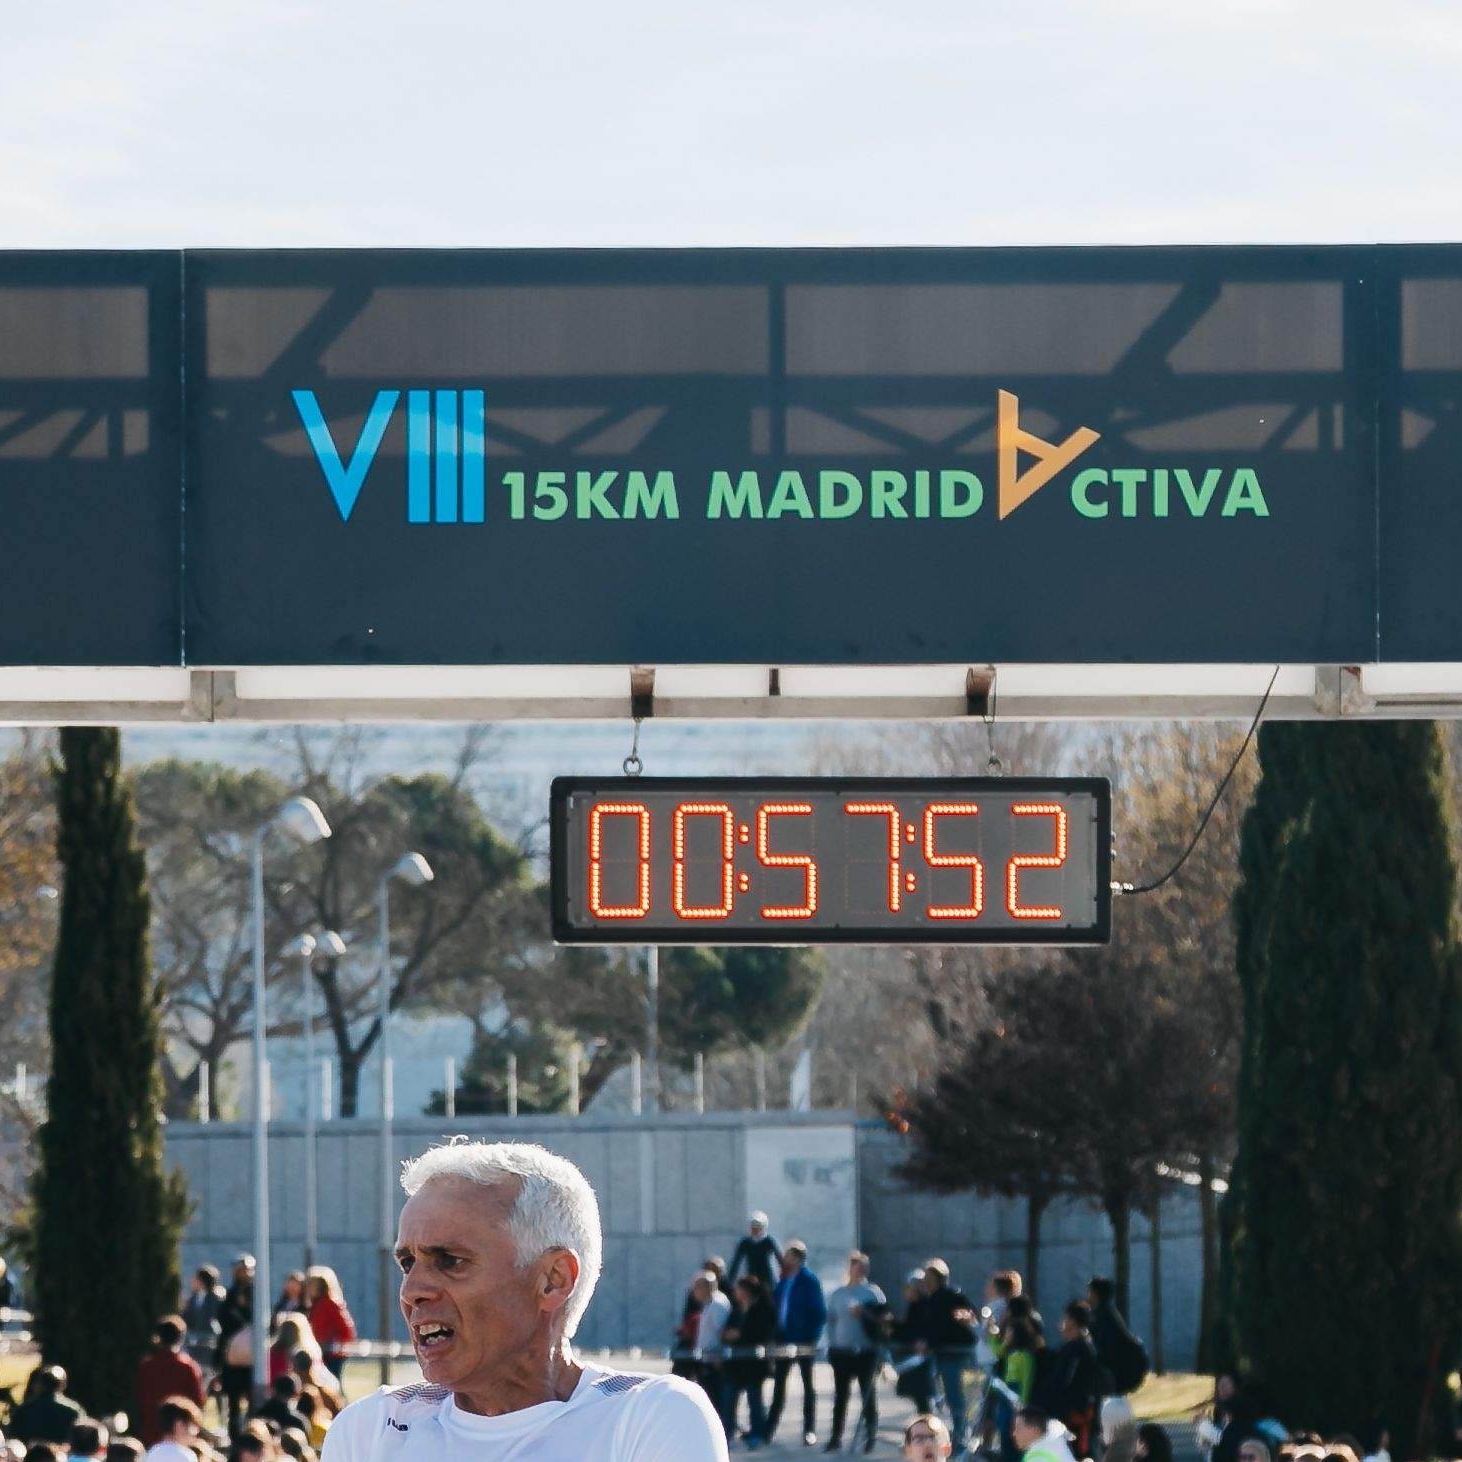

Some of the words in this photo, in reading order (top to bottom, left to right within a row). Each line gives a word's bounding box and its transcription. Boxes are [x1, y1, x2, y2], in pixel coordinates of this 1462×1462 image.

[291, 388, 485, 523] VIII
[501, 470, 680, 521] 15KM
[705, 469, 984, 521] MADRID
[588, 801, 1068, 919] 00:57:52
